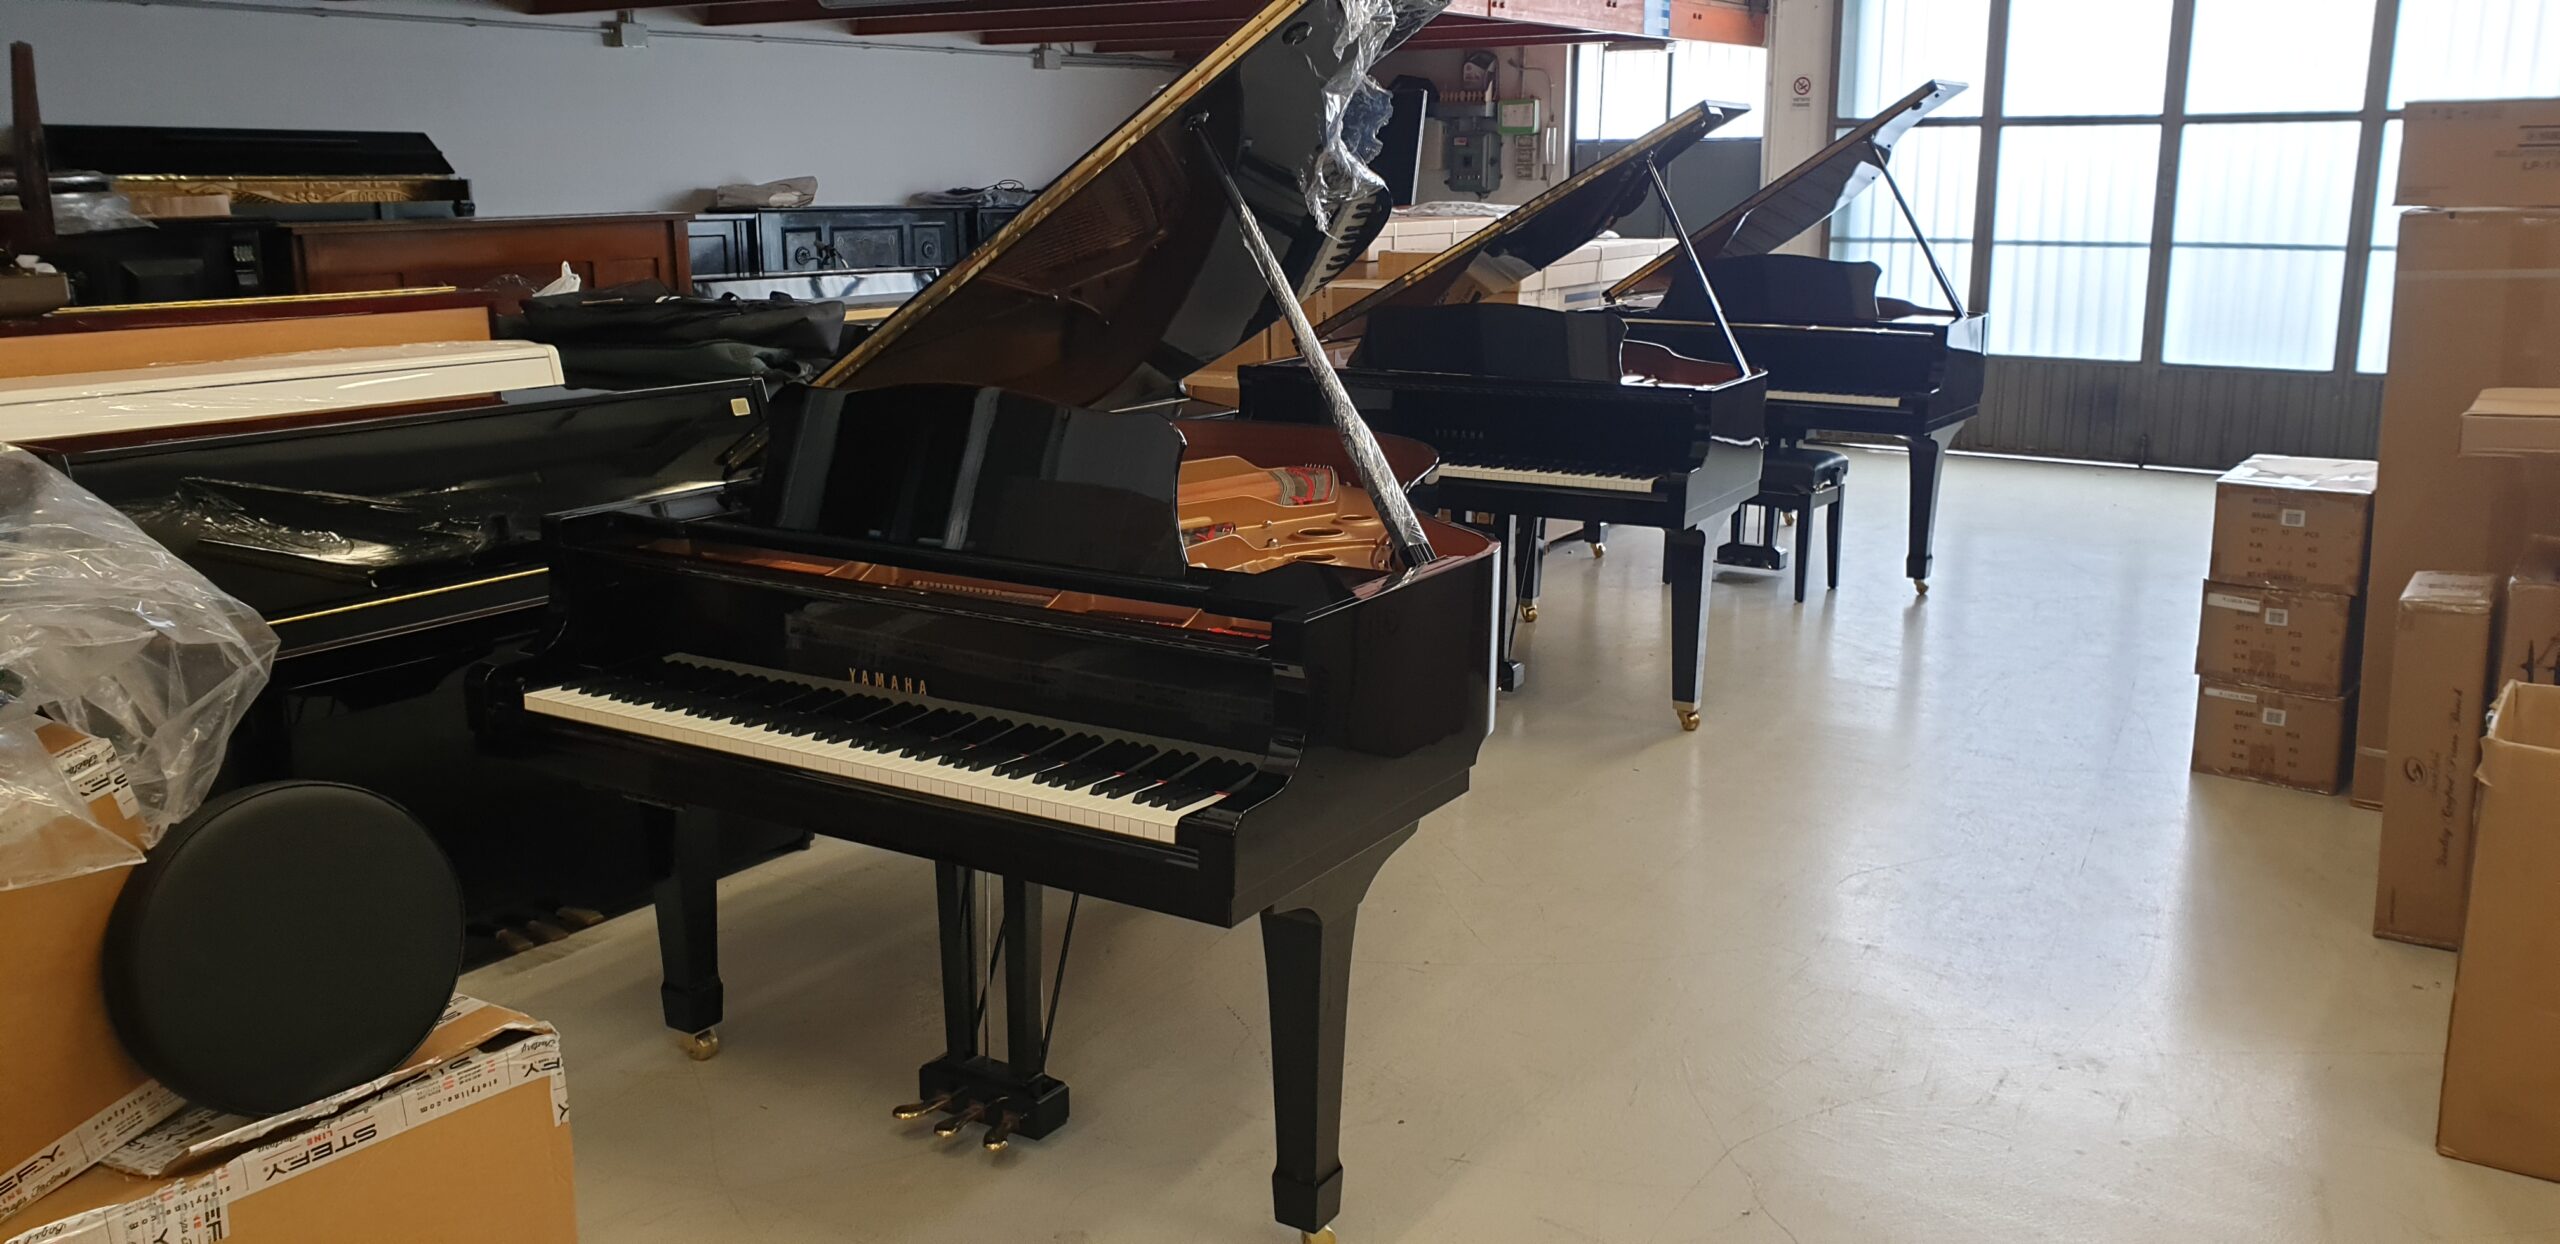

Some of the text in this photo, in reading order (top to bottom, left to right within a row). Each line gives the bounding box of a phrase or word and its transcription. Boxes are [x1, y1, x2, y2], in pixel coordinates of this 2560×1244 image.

[848, 666, 928, 696] YAMAHA
[265, 1123, 378, 1182] STEFY
[306, 1129, 334, 1147] LINE
